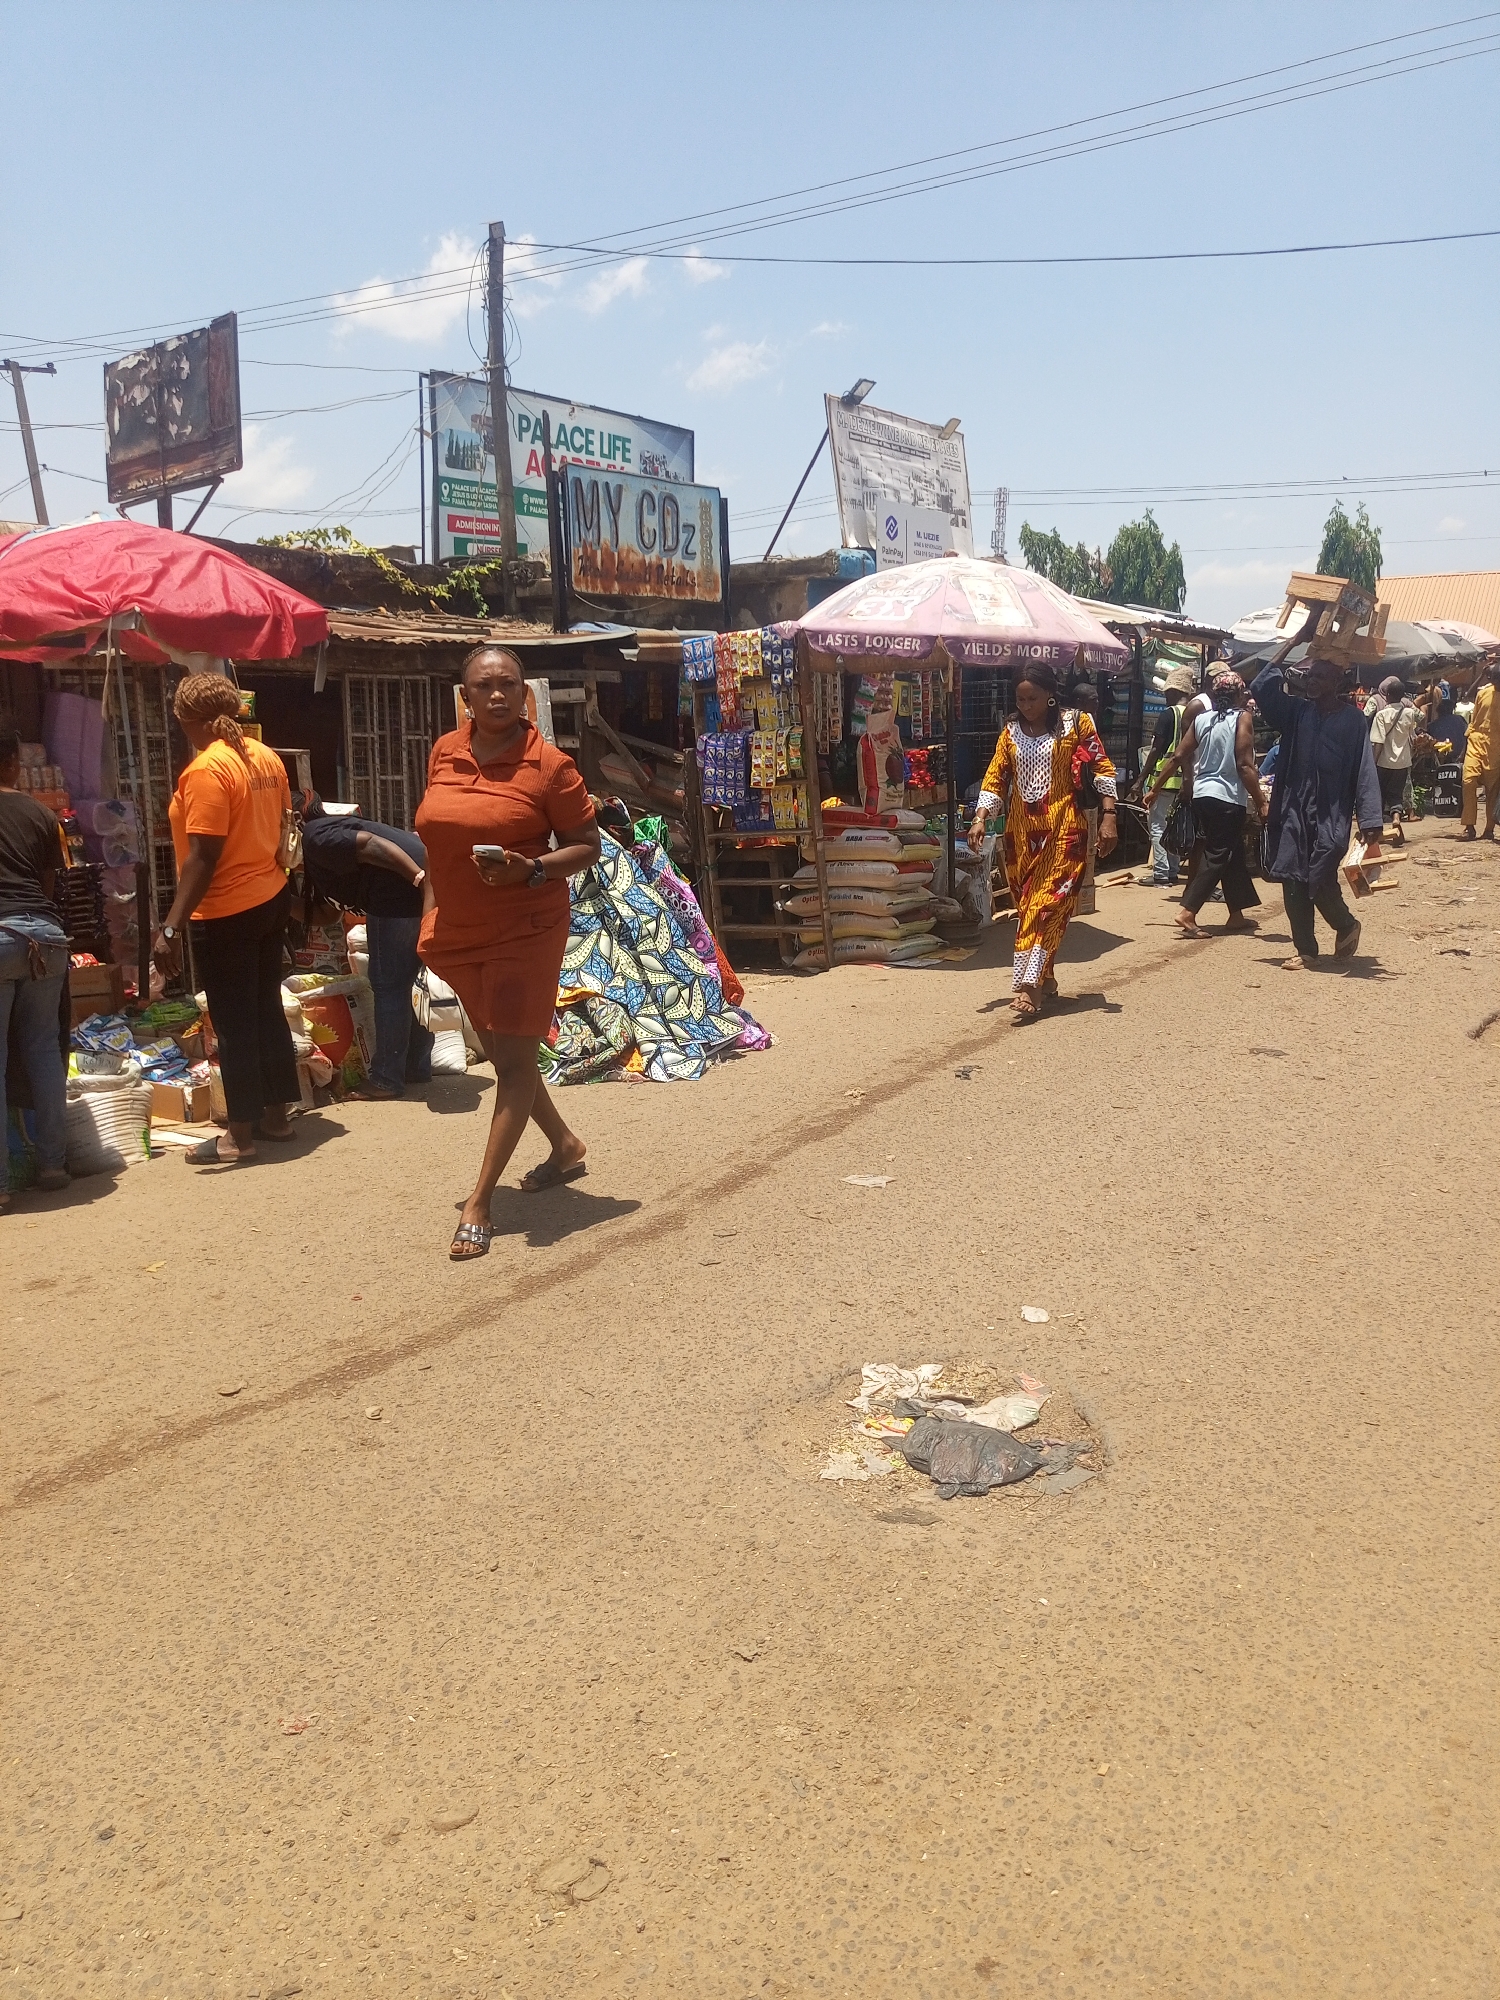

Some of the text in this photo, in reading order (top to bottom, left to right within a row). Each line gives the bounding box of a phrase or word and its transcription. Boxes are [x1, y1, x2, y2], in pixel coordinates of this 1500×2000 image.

[518, 413, 595, 456] PAACE
[600, 431, 631, 464] LIFE
[876, 421, 900, 442] WINE
[900, 429, 917, 447] AND
[917, 433, 959, 458] BEVERAGES
[455, 519, 491, 532] ADMISSION
[570, 476, 624, 552] MY
[818, 634, 921, 650] LASTS LONGER
[962, 643, 1060, 659] YIELDS MORE
